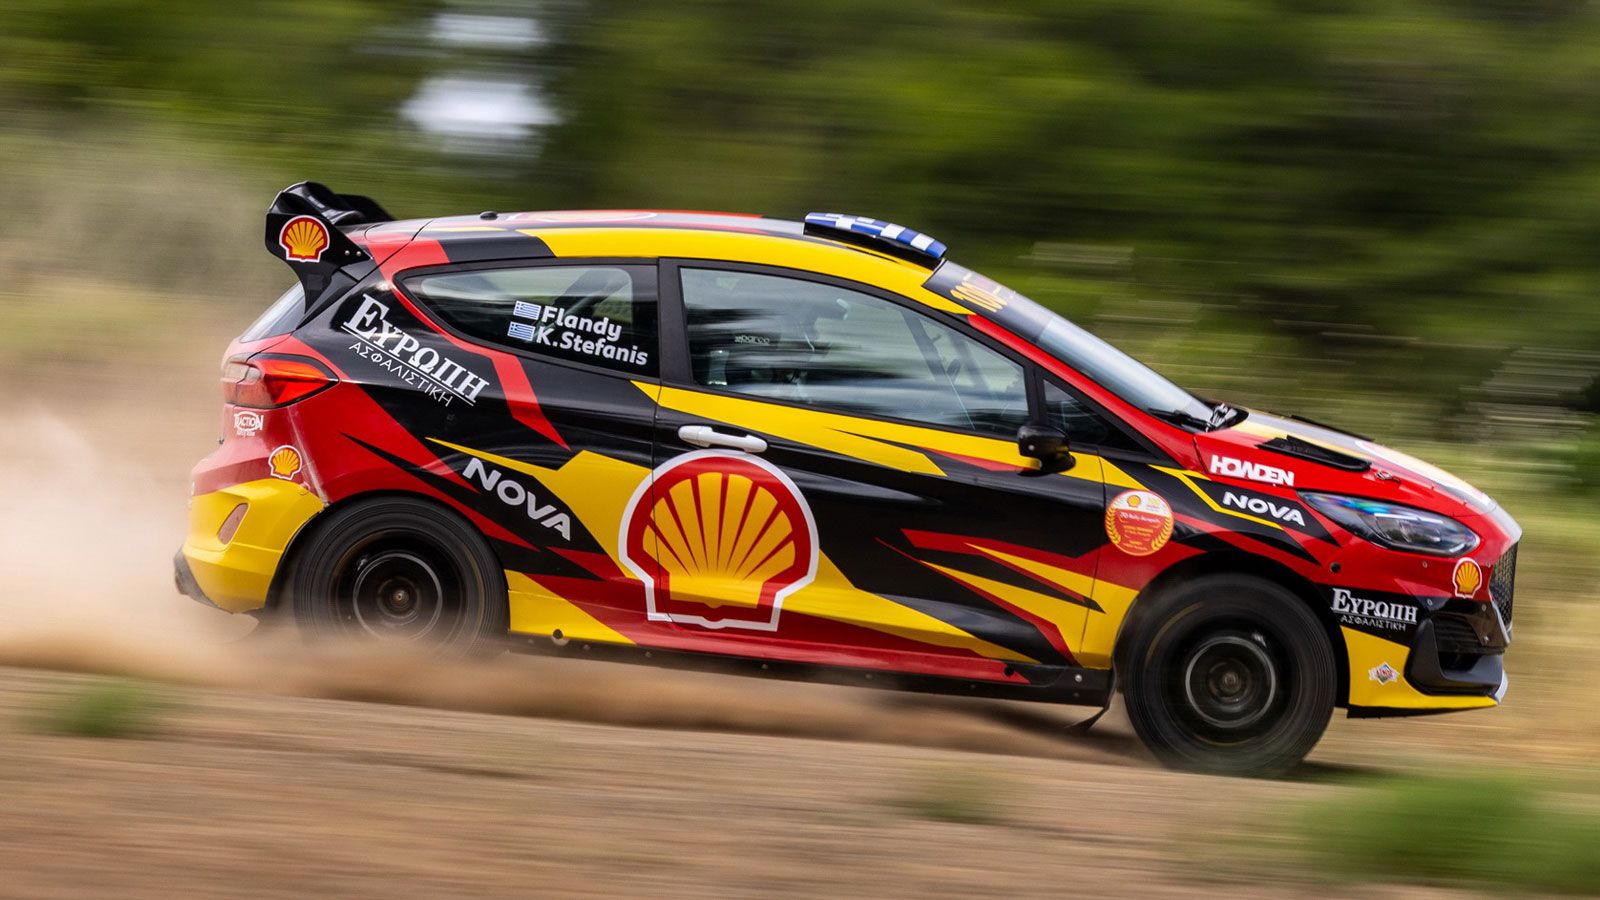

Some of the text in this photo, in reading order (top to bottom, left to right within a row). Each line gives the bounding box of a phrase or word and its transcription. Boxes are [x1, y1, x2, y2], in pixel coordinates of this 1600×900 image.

[541, 305, 622, 342] Flandy
[535, 325, 648, 366] K.Stefanis
[1210, 454, 1295, 486] HOWDEN
[461, 457, 572, 542] NOVA
[1222, 491, 1306, 527] NOVA
